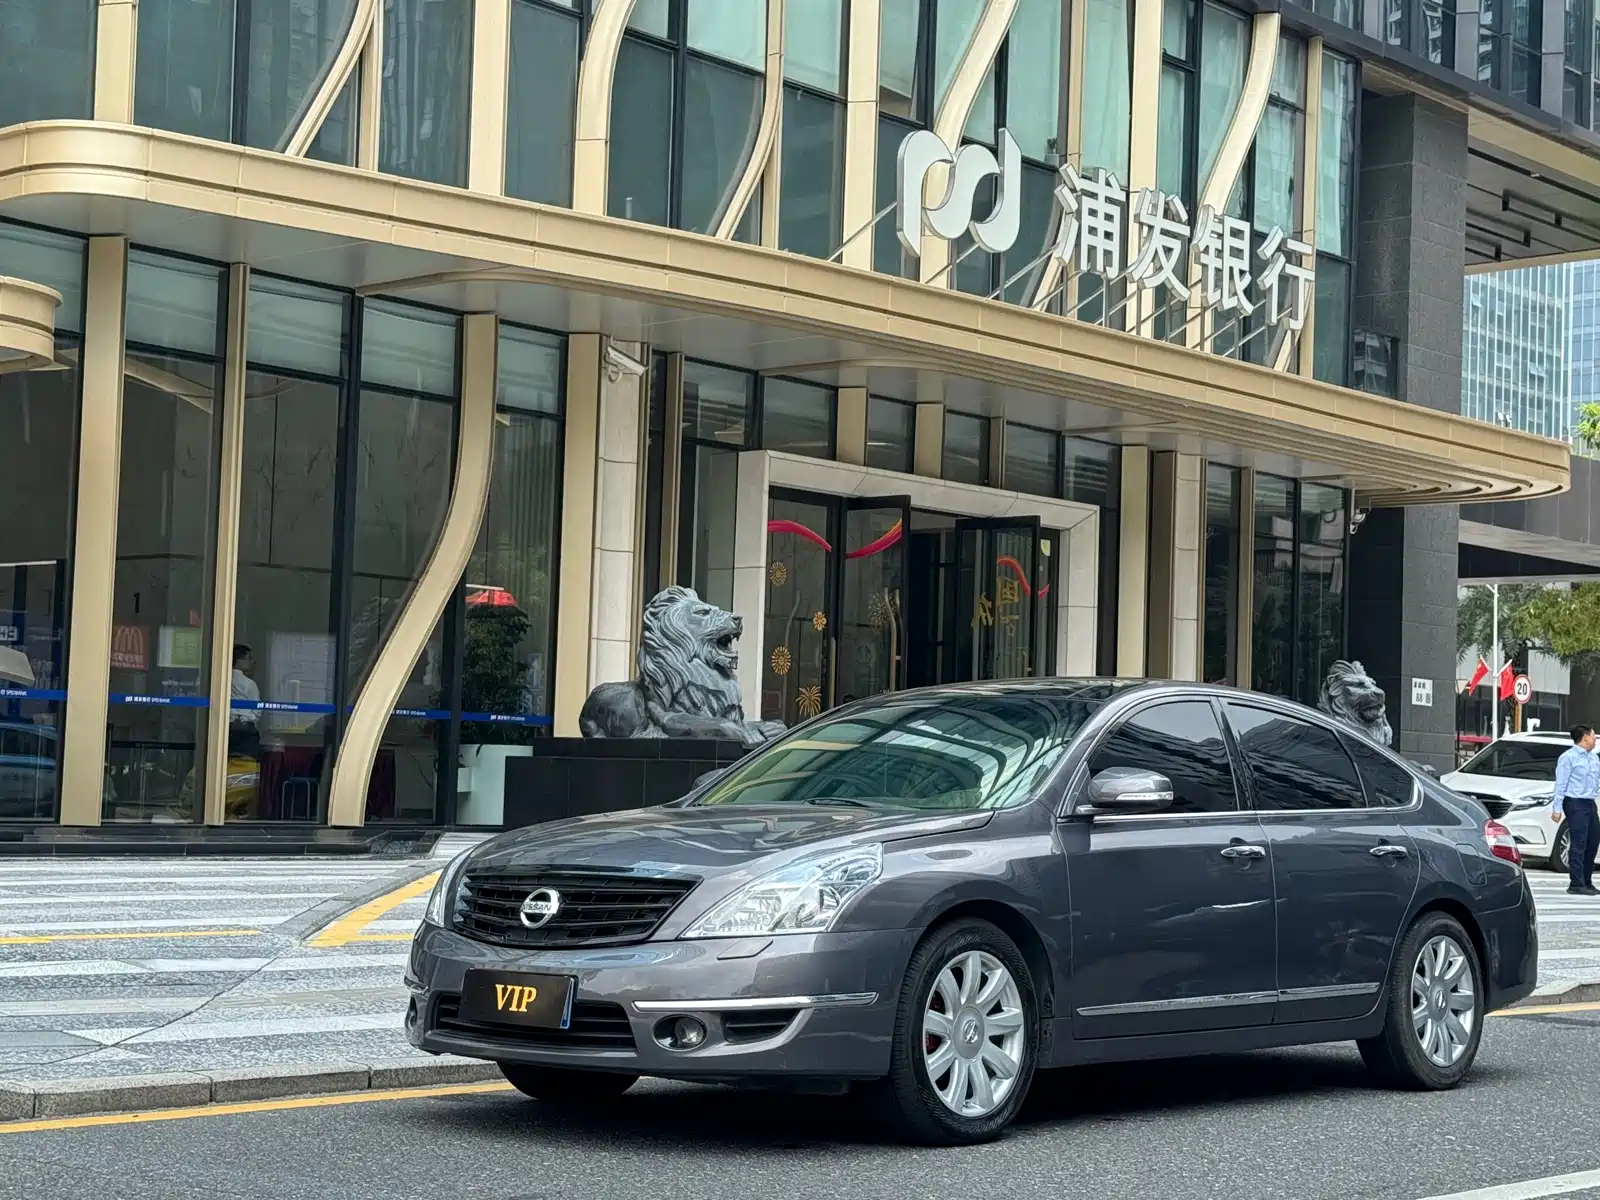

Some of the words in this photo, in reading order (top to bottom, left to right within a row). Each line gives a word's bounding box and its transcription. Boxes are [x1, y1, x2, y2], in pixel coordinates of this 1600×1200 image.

[1054, 162, 1316, 331] 浦发银行
[1517, 682, 1528, 696] 20
[520, 901, 552, 911] NISSAN
[494, 983, 538, 1013] VIP
